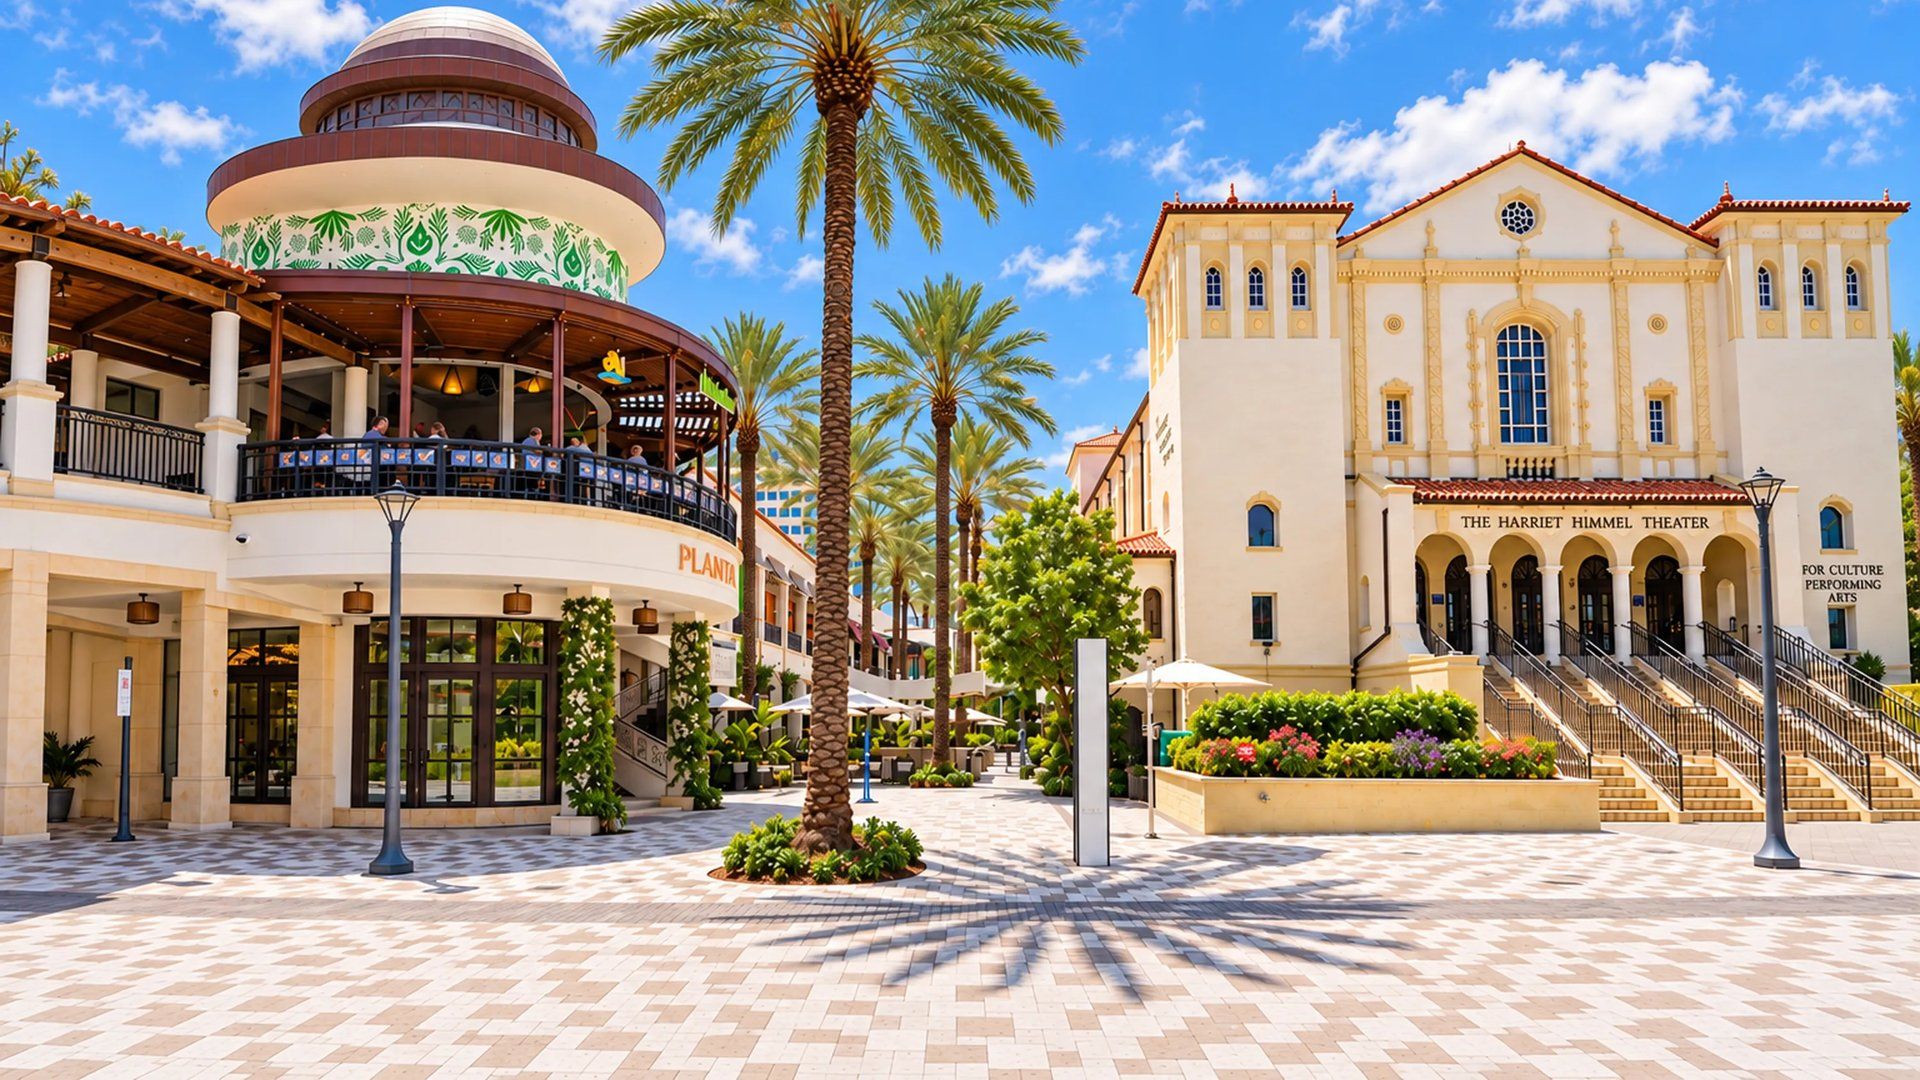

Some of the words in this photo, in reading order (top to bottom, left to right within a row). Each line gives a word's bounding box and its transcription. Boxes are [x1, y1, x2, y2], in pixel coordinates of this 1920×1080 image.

[1461, 516, 1491, 528] THE
[1498, 516, 1563, 528] HARRIET
[1572, 516, 1632, 529] HIMMEL
[1642, 516, 1709, 529] THEATER
[679, 543, 736, 589] PLANTA
[1802, 565, 1825, 575] FOR
[1829, 565, 1884, 576] CULTURE
[1828, 592, 1857, 603] ARTS
